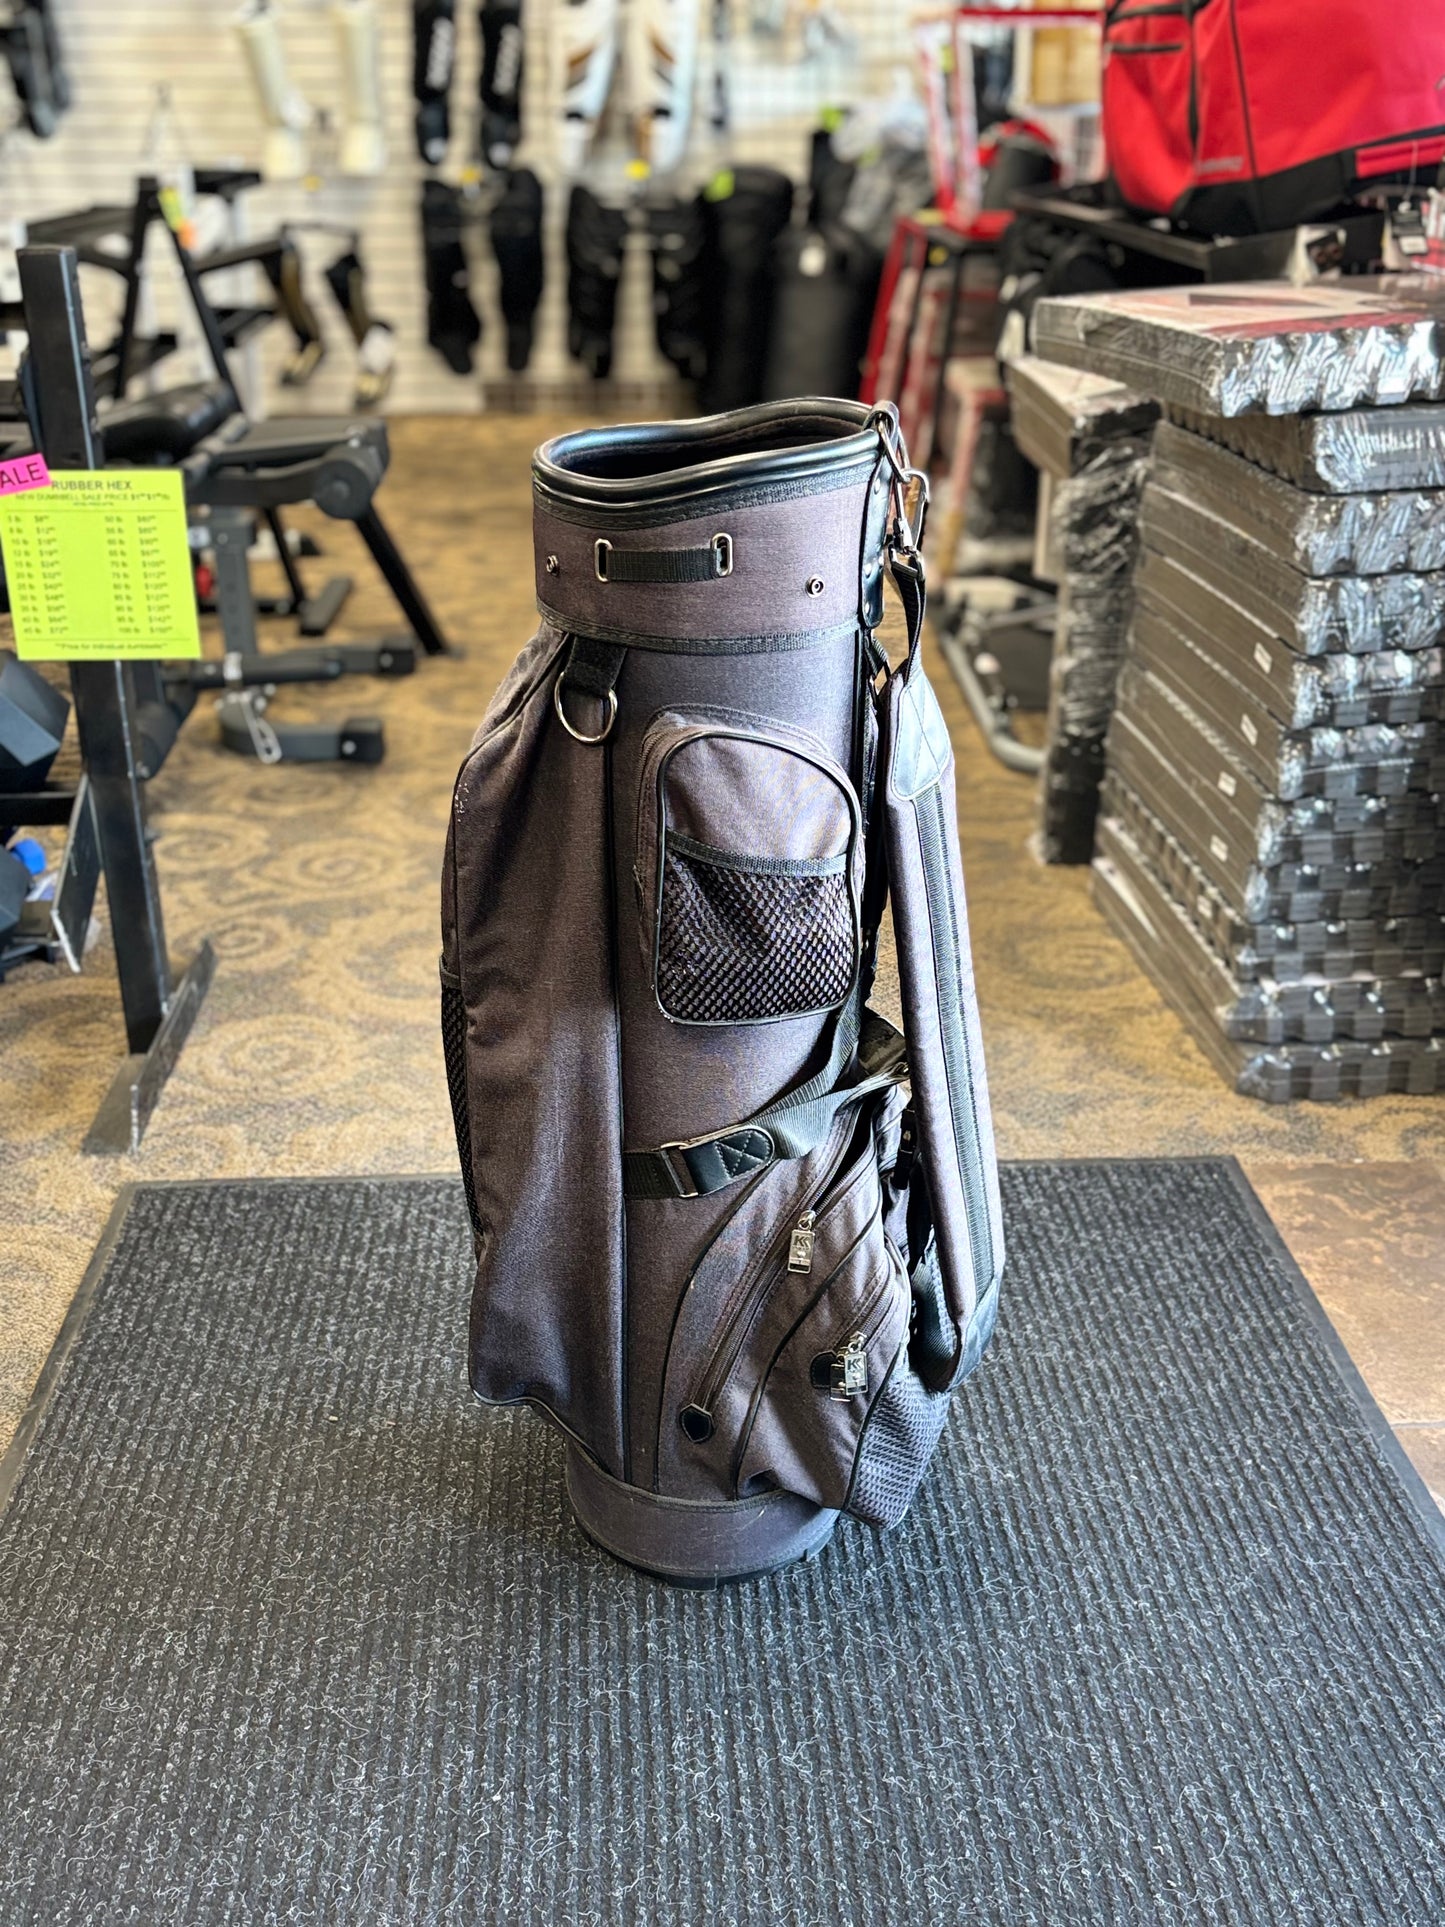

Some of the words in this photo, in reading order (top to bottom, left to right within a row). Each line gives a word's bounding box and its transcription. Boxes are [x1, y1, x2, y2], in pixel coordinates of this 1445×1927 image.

[0, 462, 44, 488] ALE
[51, 480, 103, 490] RUBBER
[107, 480, 132, 490] HEX
